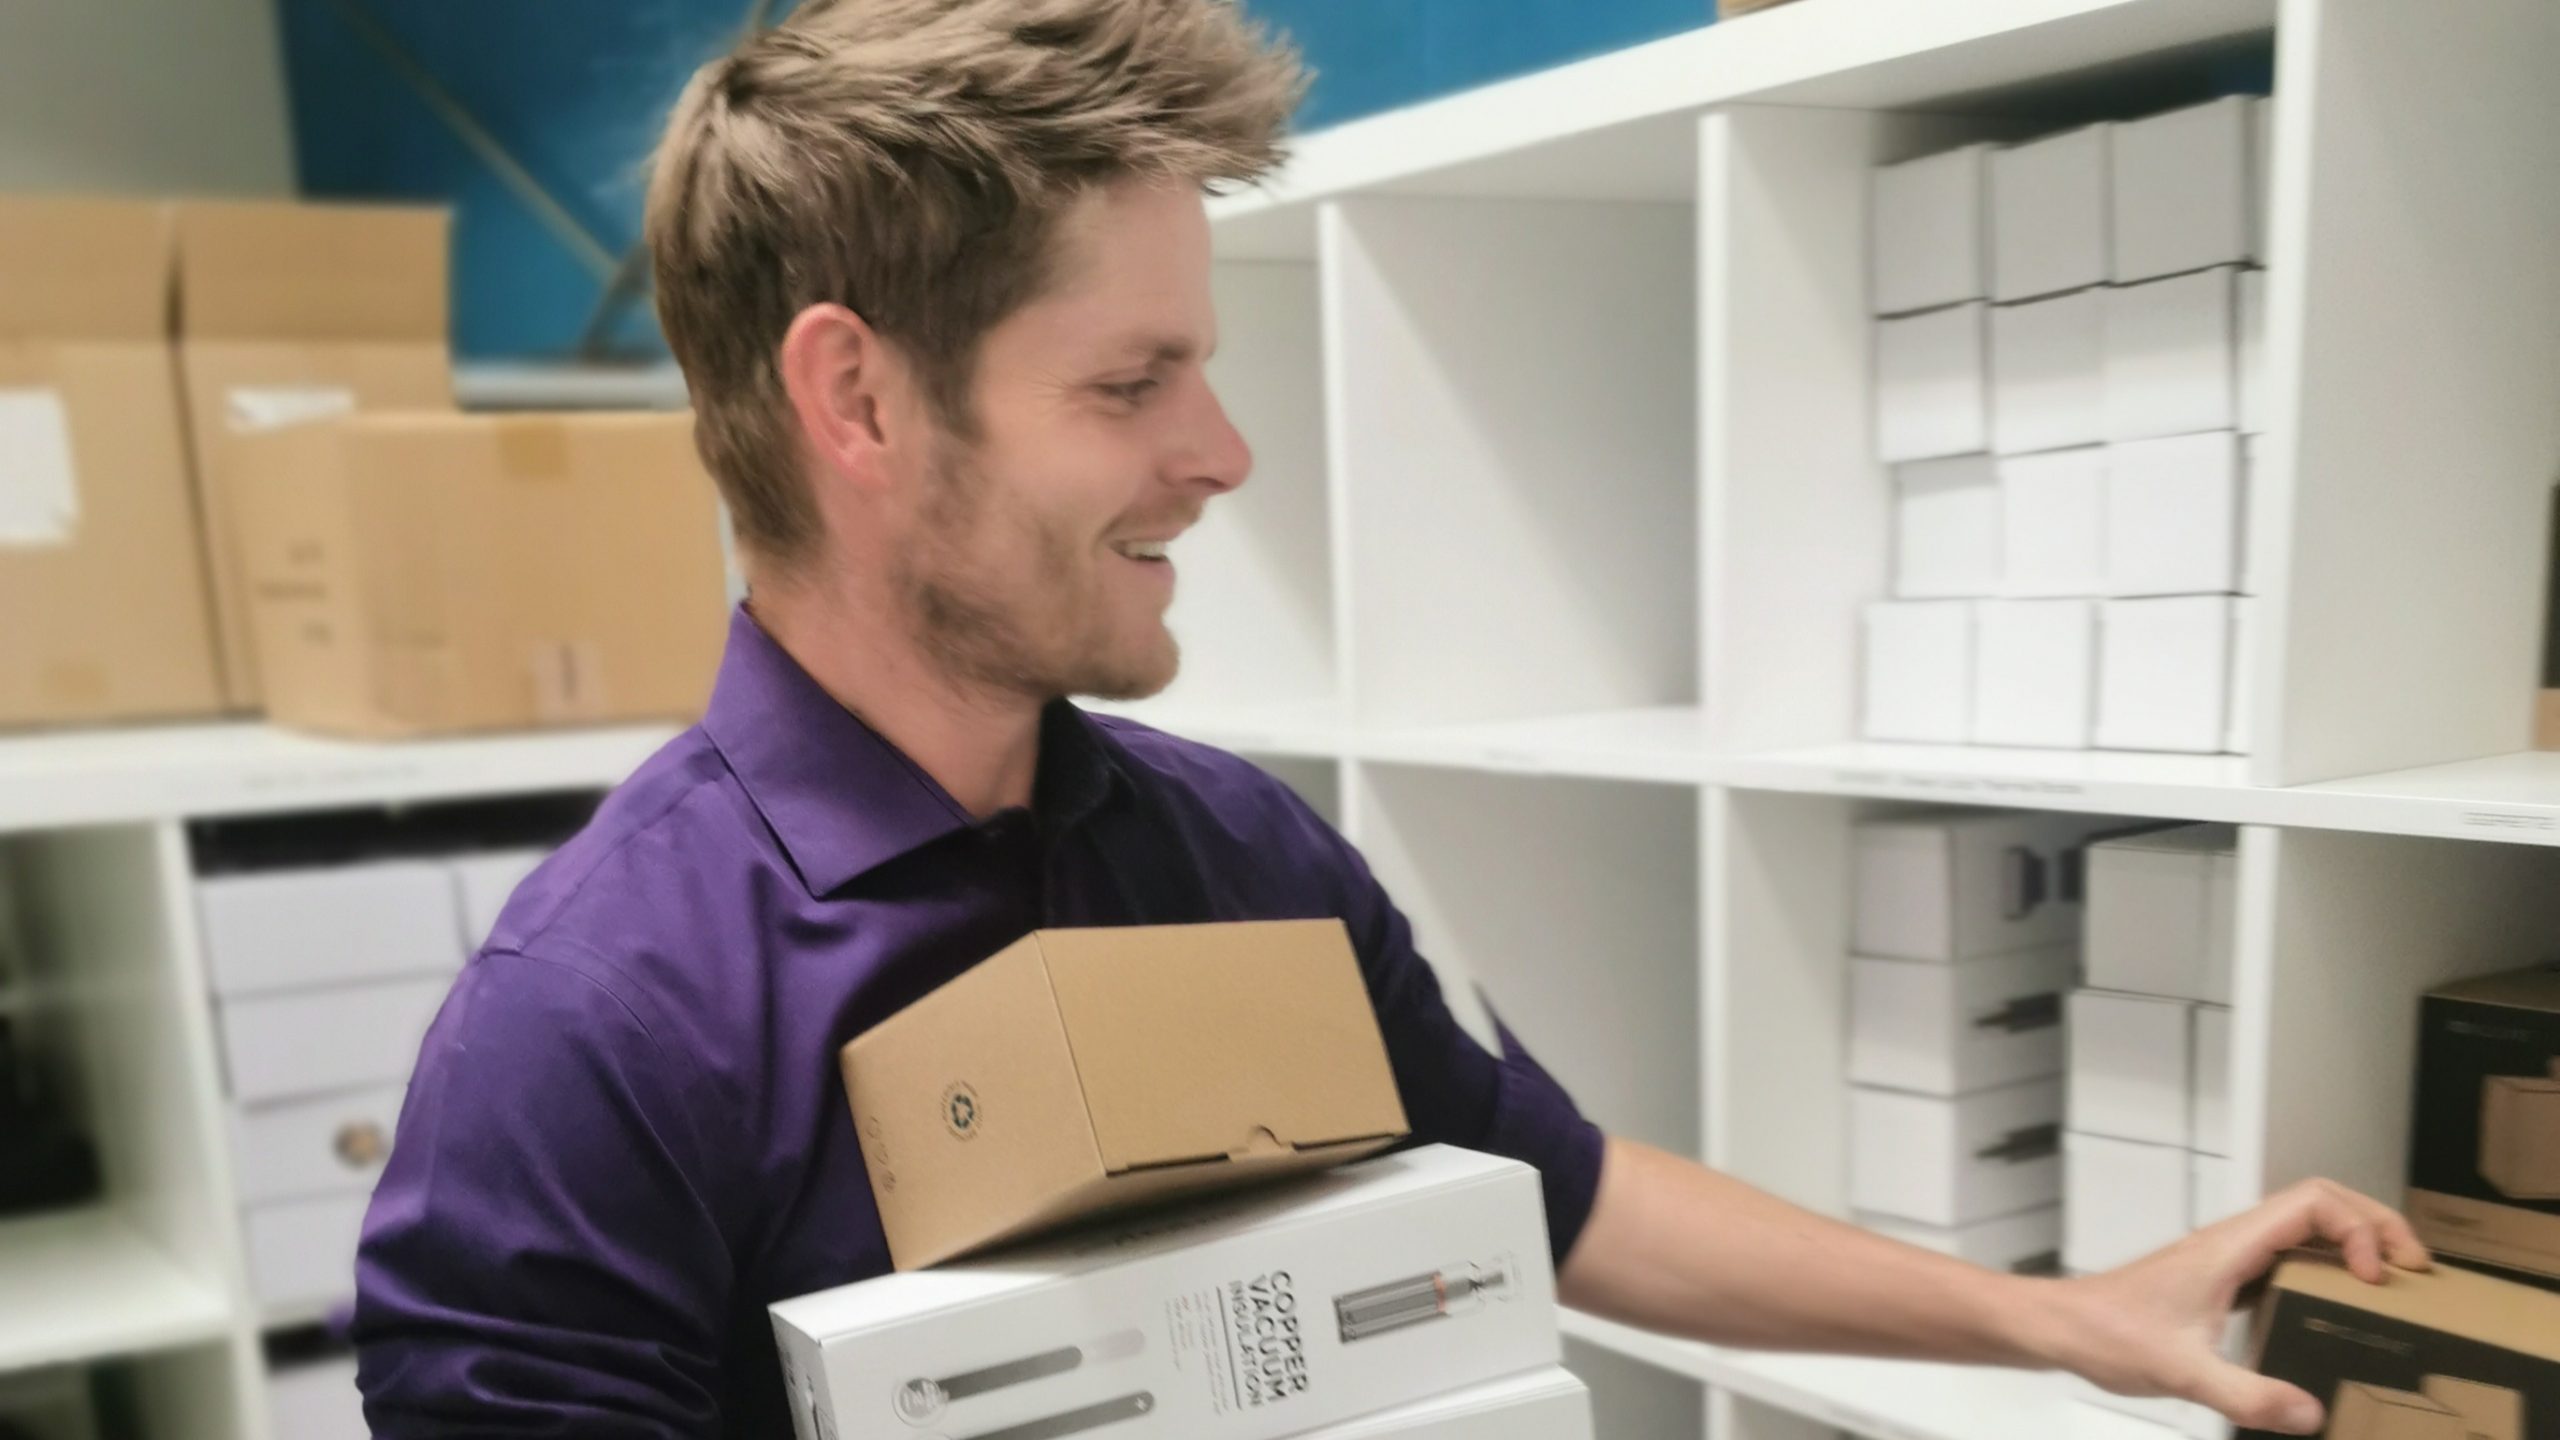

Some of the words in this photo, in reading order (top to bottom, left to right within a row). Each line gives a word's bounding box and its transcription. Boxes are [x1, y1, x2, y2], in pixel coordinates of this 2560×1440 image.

[1229, 1280, 1262, 1406] INSULATION
[1248, 1274, 1287, 1402] VACUUM
[1270, 1270, 1308, 1392] COPPER
